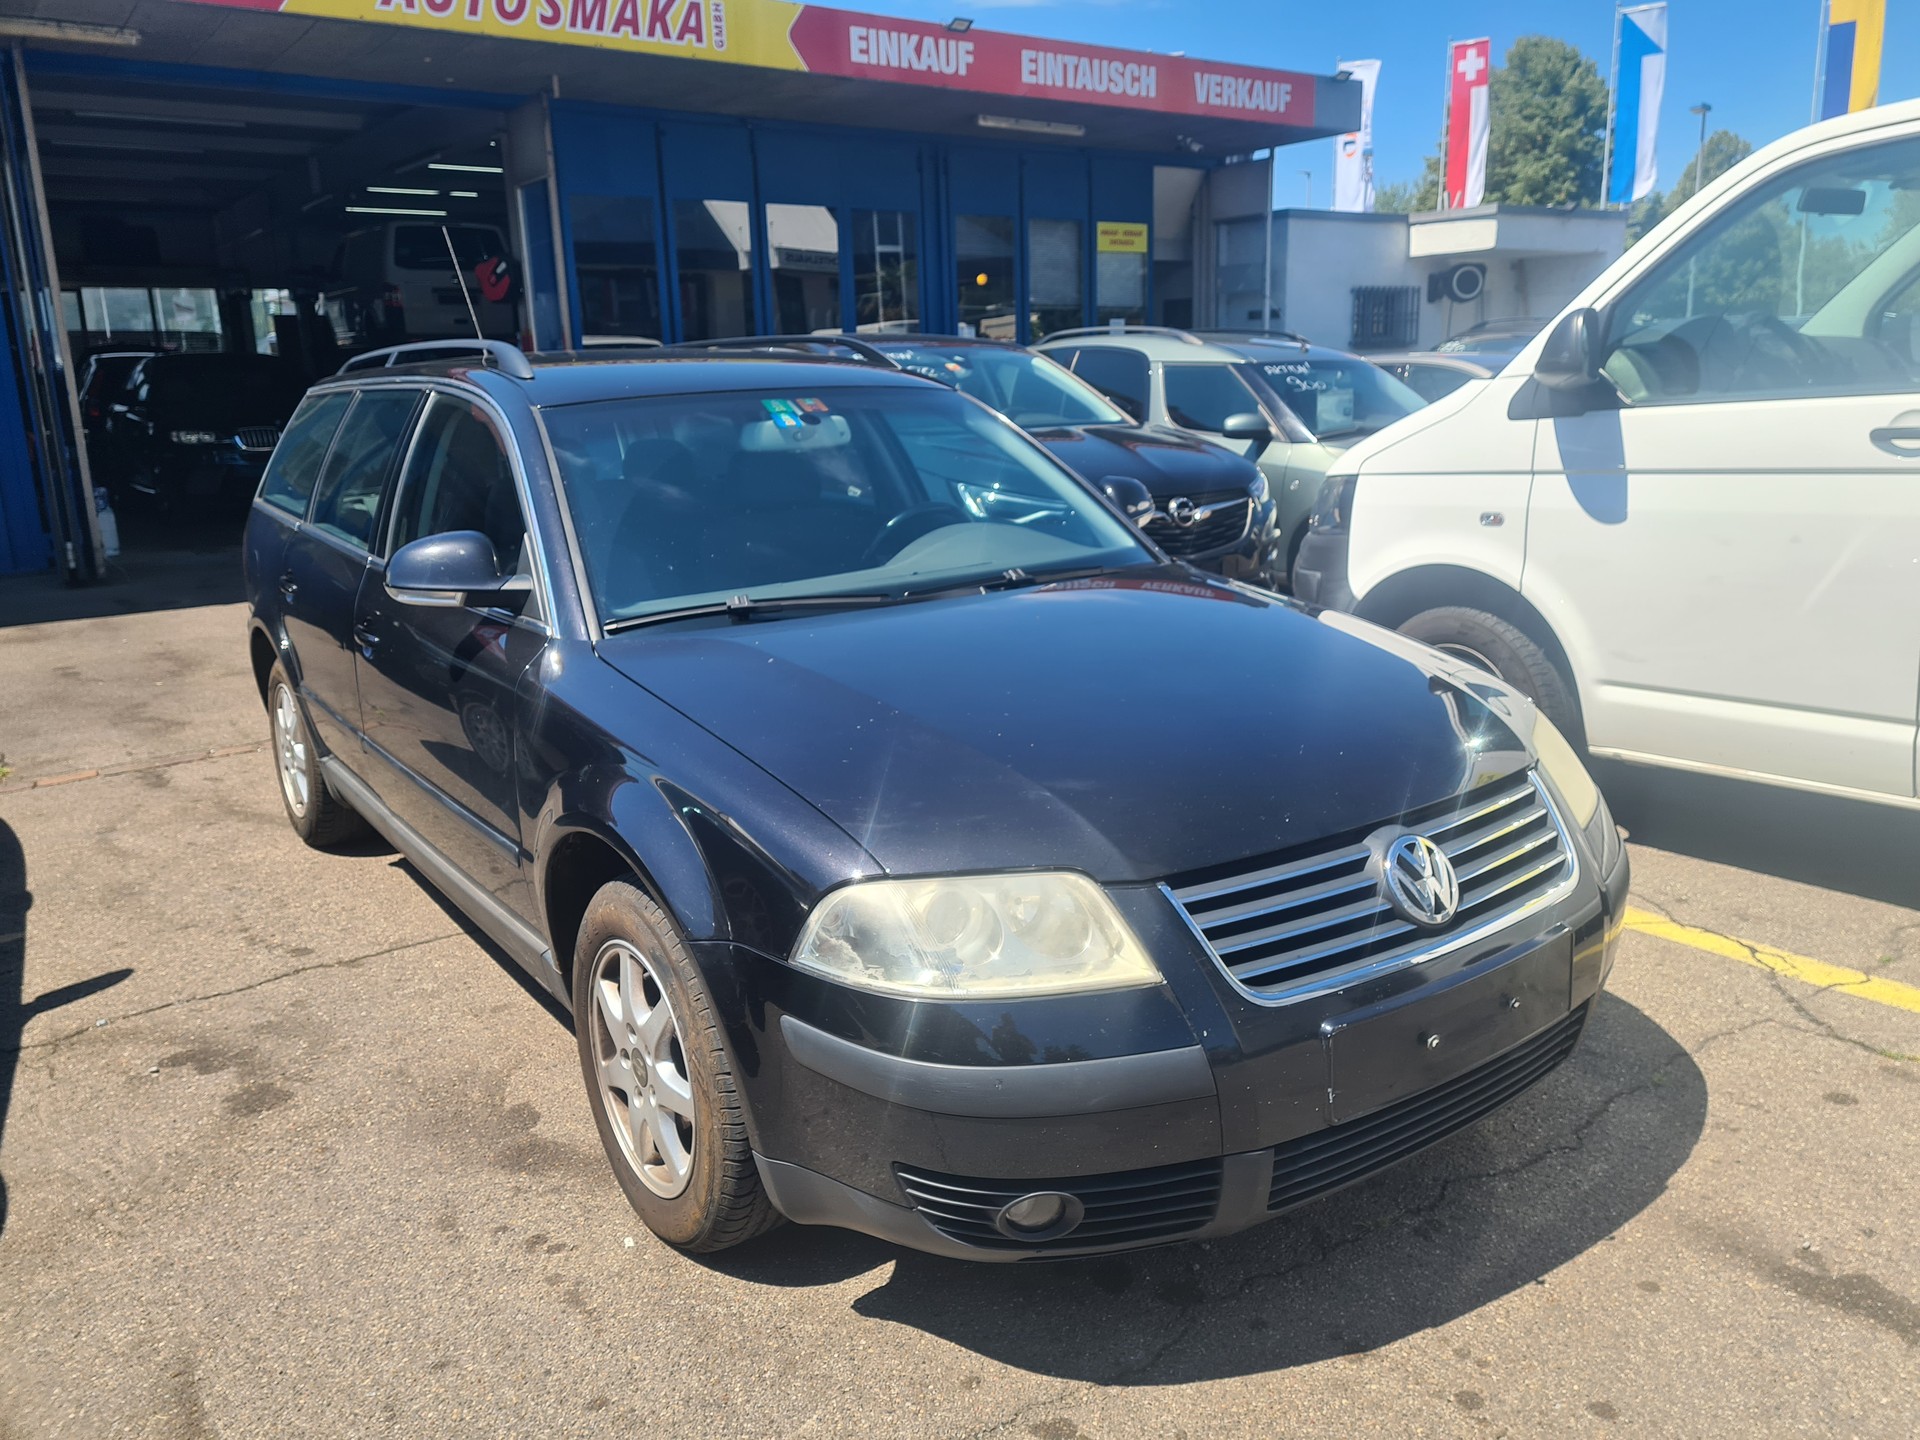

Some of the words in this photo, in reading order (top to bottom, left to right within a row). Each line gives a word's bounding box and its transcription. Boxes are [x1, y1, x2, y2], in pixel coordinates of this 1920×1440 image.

[380, 0, 704, 45] SMAKA
[849, 25, 975, 76] EINKAUF
[1020, 48, 1157, 98] EINTAUSCH
[1193, 72, 1293, 113] VERKAUF
